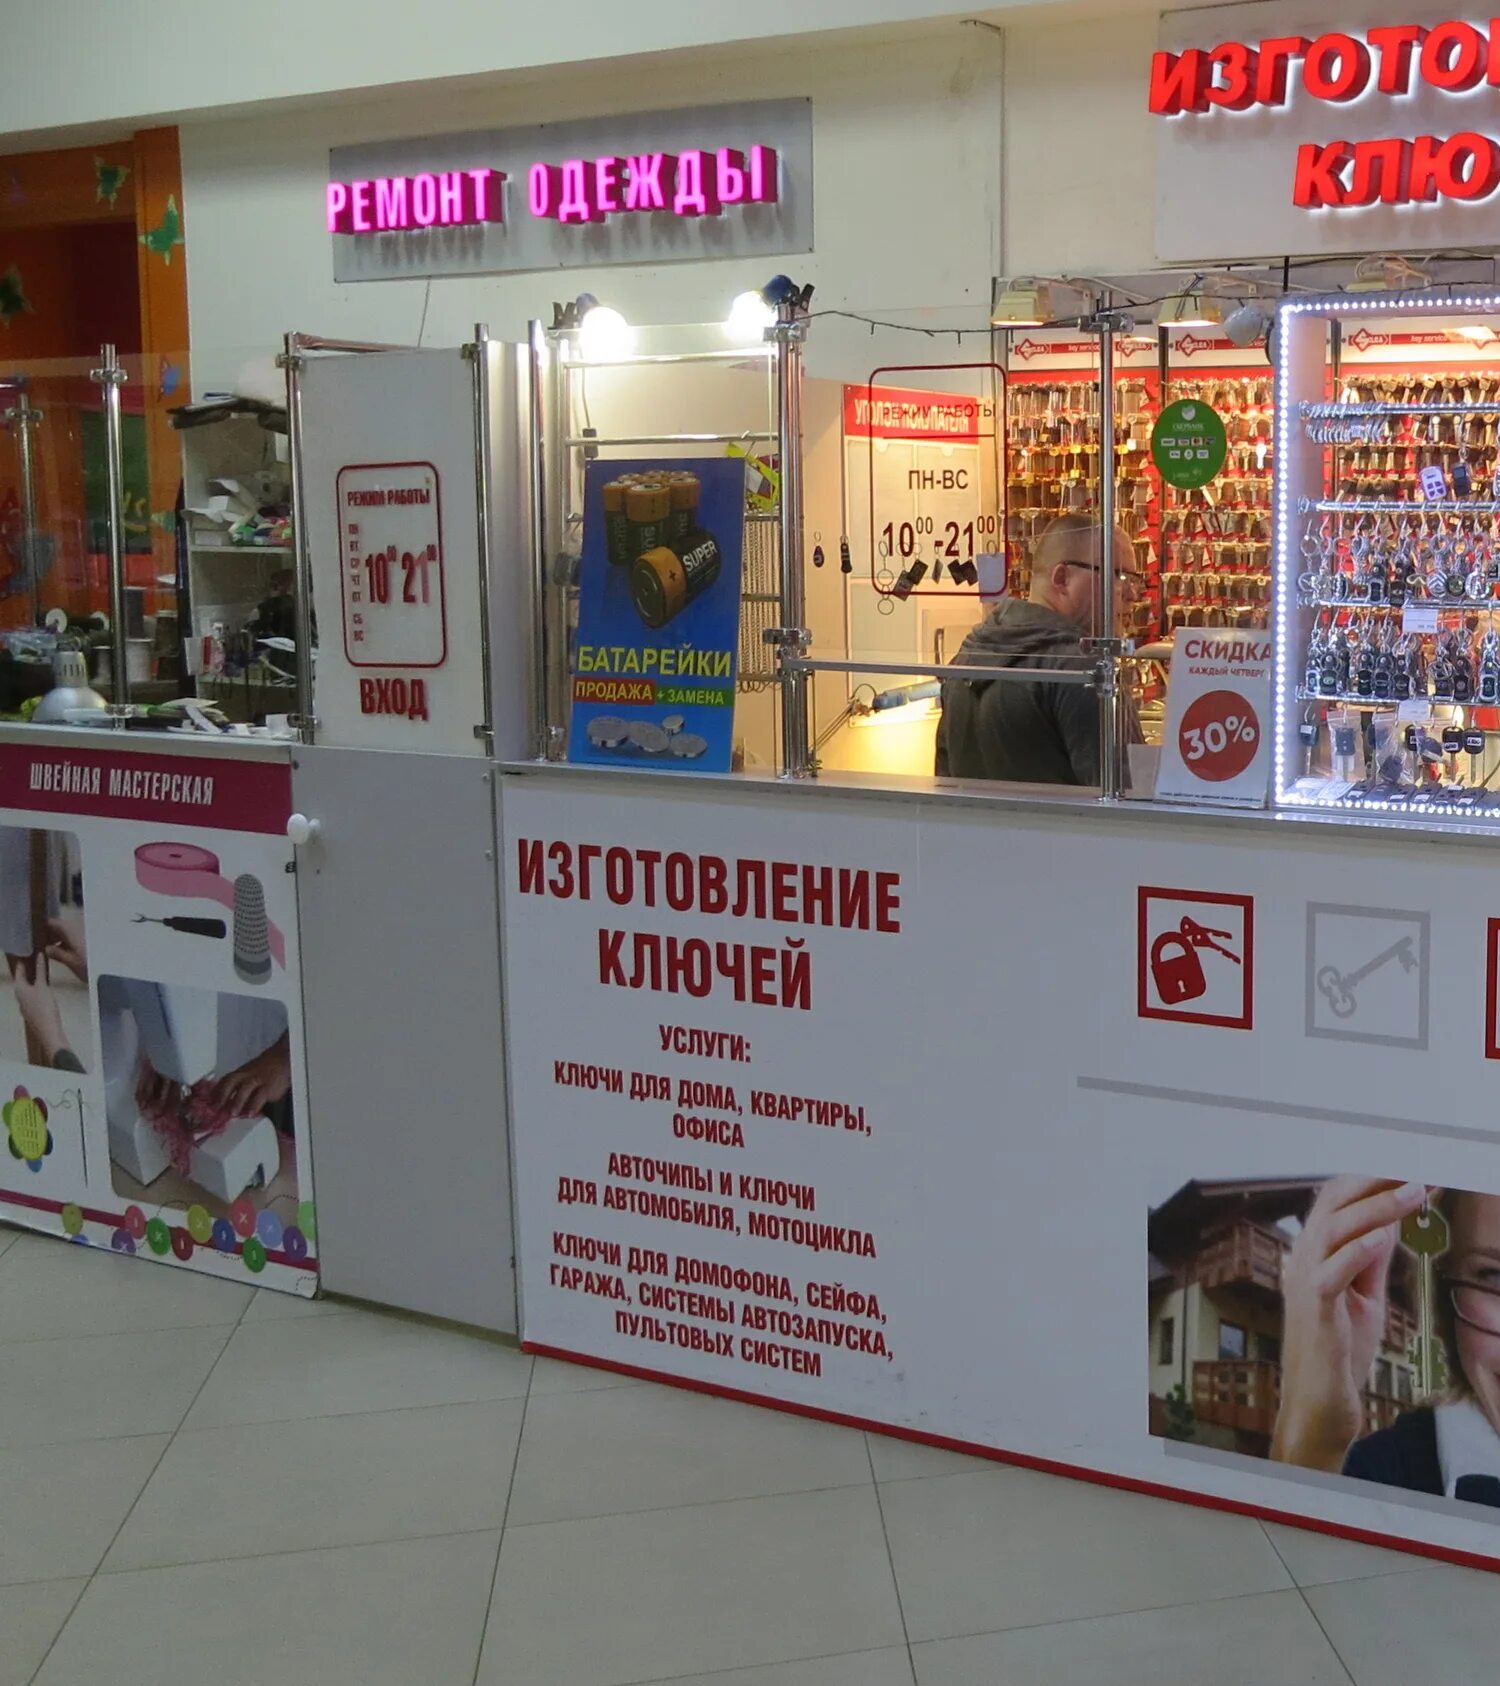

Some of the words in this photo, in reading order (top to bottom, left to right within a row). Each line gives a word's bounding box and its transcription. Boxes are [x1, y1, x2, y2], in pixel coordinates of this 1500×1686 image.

[327, 169, 503, 234] РЕМОНТ
[528, 145, 776, 224] ОДЕЖДЫ
[347, 491, 385, 506] РЕЖИМ
[387, 488, 430, 504] РАБОТЫ
[907, 469, 969, 490] ПН-ВС
[682, 540, 718, 572] SUPER
[578, 643, 731, 677] БАТАРЕЙКИ
[1185, 639, 1272, 664] СКИДКА
[1189, 666, 1229, 676] КАЖДЫЙ
[360, 678, 429, 721] ВХОД
[576, 680, 653, 701] ПРОДАЖА
[667, 689, 724, 705] ЗАМЕНА
[1183, 715, 1255, 760] 30%
[30, 761, 101, 795] ШВЕЙНАЯ
[109, 769, 214, 805] МАСТЕРСКАЯ
[518, 838, 900, 933] ИЗГОТОВЛЕНИЕ
[598, 928, 812, 1010] КЛЮЧЕЙ
[659, 1024, 751, 1063] УСЛУГИ:
[554, 1060, 624, 1093] КЛЮЧИ
[629, 1072, 671, 1101] ДЛЯ
[678, 1079, 743, 1115] ДОМА,
[751, 1090, 872, 1136] КВАРТИРЫ,
[673, 1113, 745, 1148] ОФИСА
[608, 1152, 713, 1193] АВТОЧИПЫ
[719, 1172, 732, 1196] И
[739, 1174, 815, 1211] КЛЮЧИ
[557, 1176, 597, 1205] ДЛЯ
[603, 1185, 741, 1237] АВТОМОБИЛЯ,
[748, 1211, 877, 1258] МОТОЦИКЛА
[553, 1231, 622, 1267] КЛЮЧИ
[627, 1247, 669, 1276] ДЛЯ
[674, 1256, 799, 1307] ДОМОФОНА,
[806, 1280, 887, 1326] СЕЙФА,
[550, 1263, 632, 1306] ГАРАЖА,
[638, 1282, 735, 1325] СИСТЕМЫ
[740, 1304, 893, 1362] АВТОЗАПУСКА,
[615, 1310, 735, 1358] ПУЛЬТОВЫХ
[740, 1337, 822, 1378] СИСТЕМ
